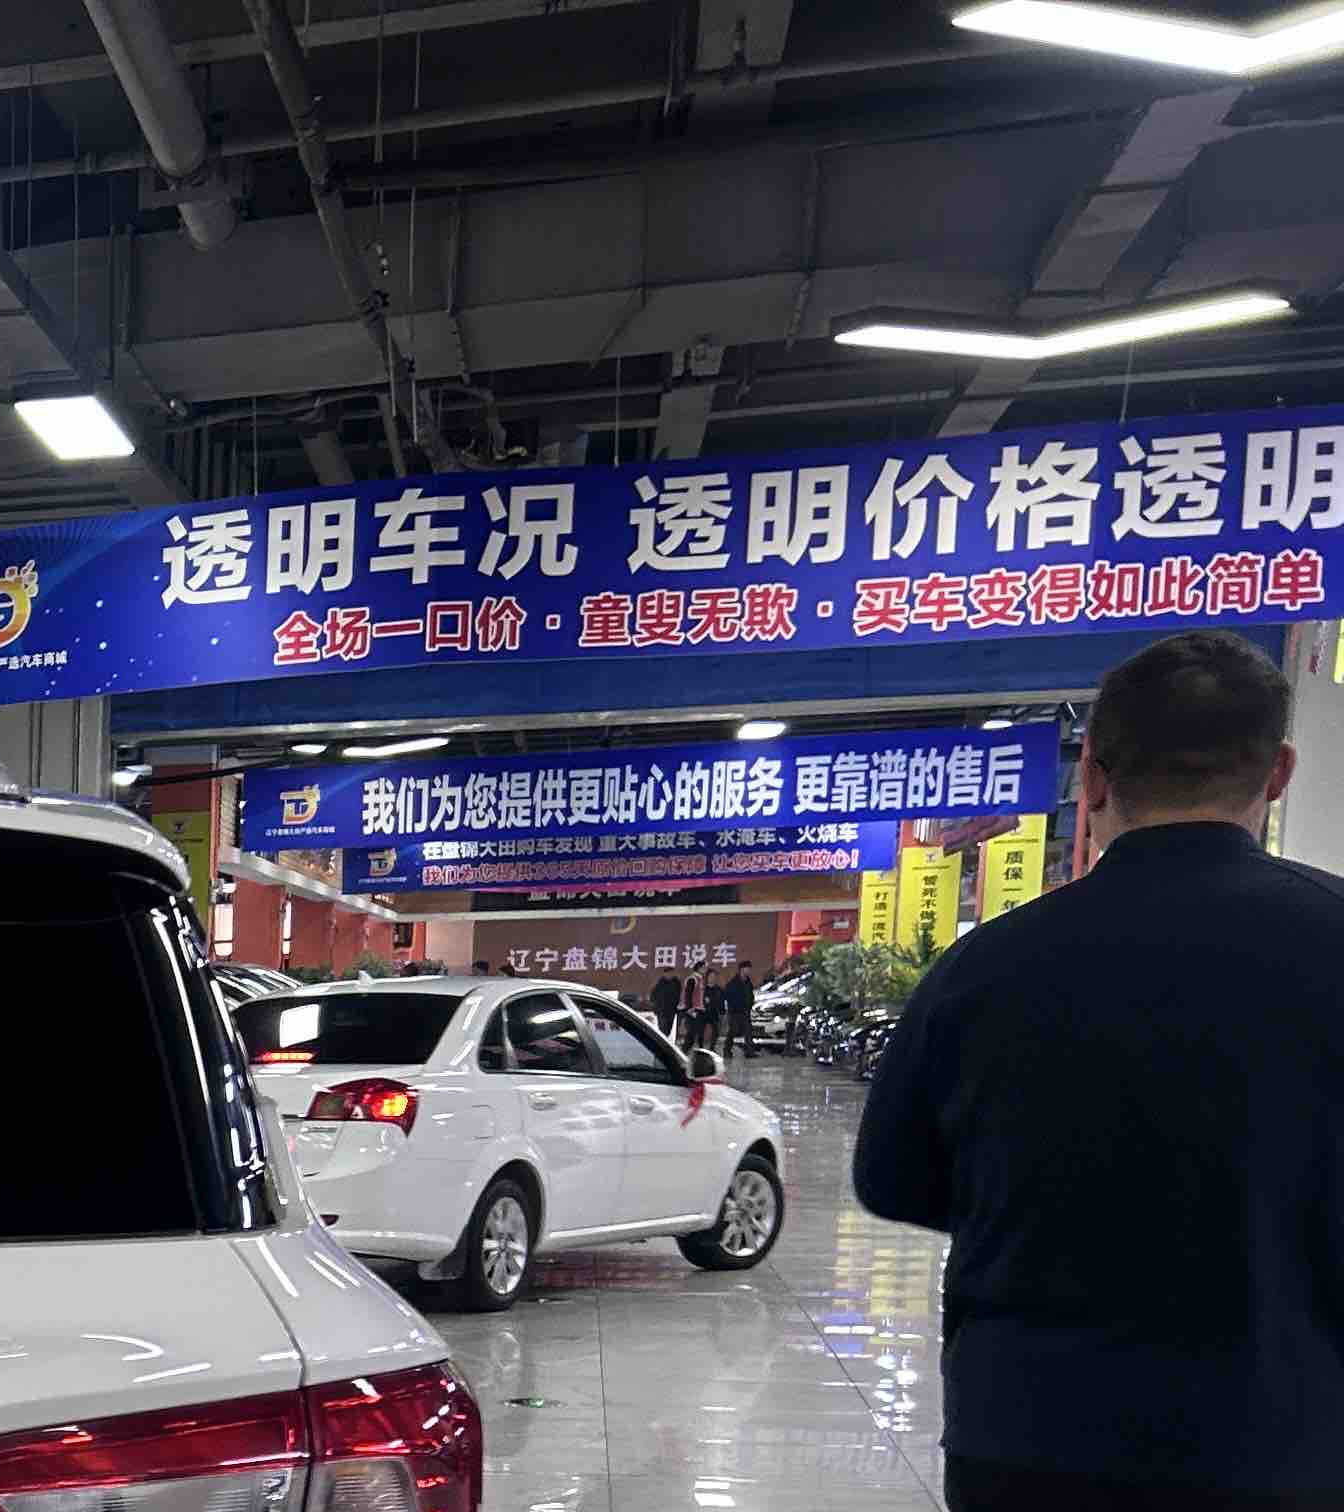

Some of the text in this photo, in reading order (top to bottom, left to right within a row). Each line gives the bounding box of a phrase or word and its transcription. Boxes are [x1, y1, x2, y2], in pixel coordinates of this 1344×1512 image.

[161, 424, 1344, 609] 透明车况 透明价格透明
[362, 743, 1025, 835] 我们为您提供更贴心的服务 更靠谱的售后
[872, 891, 889, 944] 打造一流汽
[507, 943, 737, 972] 辽宁盘锦大田说车
